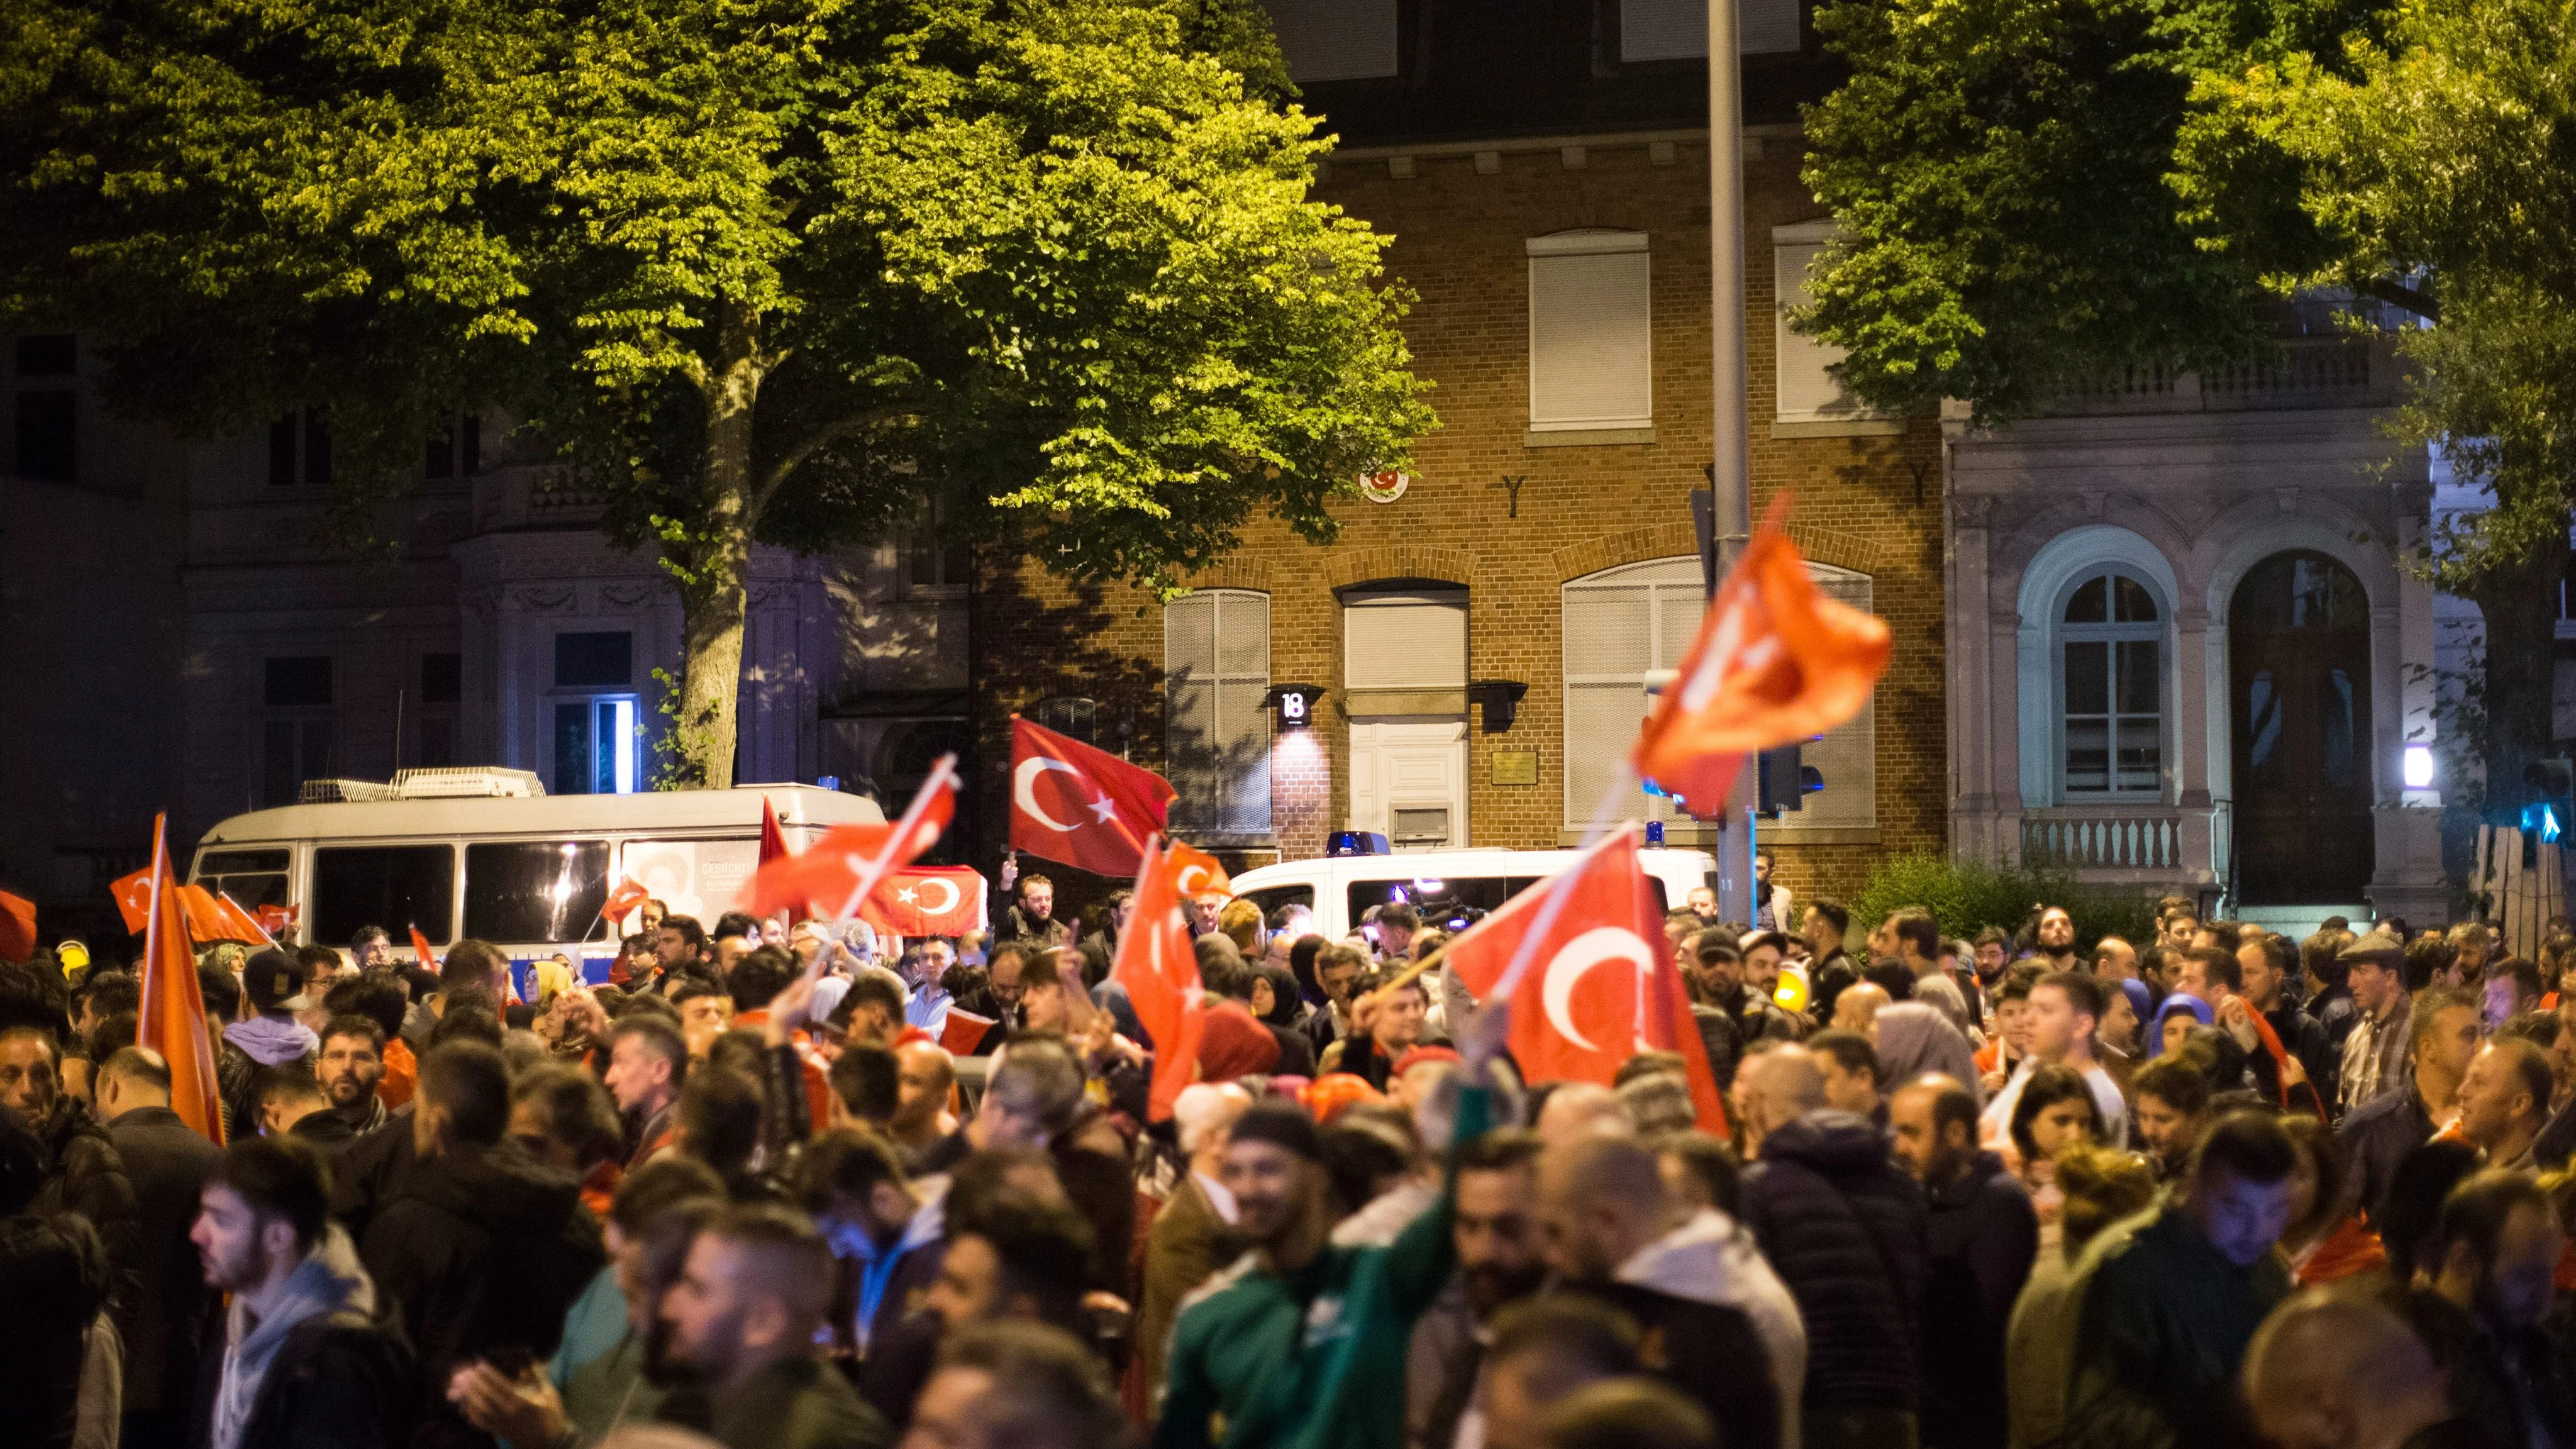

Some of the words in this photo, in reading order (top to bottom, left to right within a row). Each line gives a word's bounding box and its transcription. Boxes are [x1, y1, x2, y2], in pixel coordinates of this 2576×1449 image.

[1282, 693, 1304, 718] 18
[702, 862, 750, 874] GESUCHT!
[1721, 878, 1732, 891] 11
